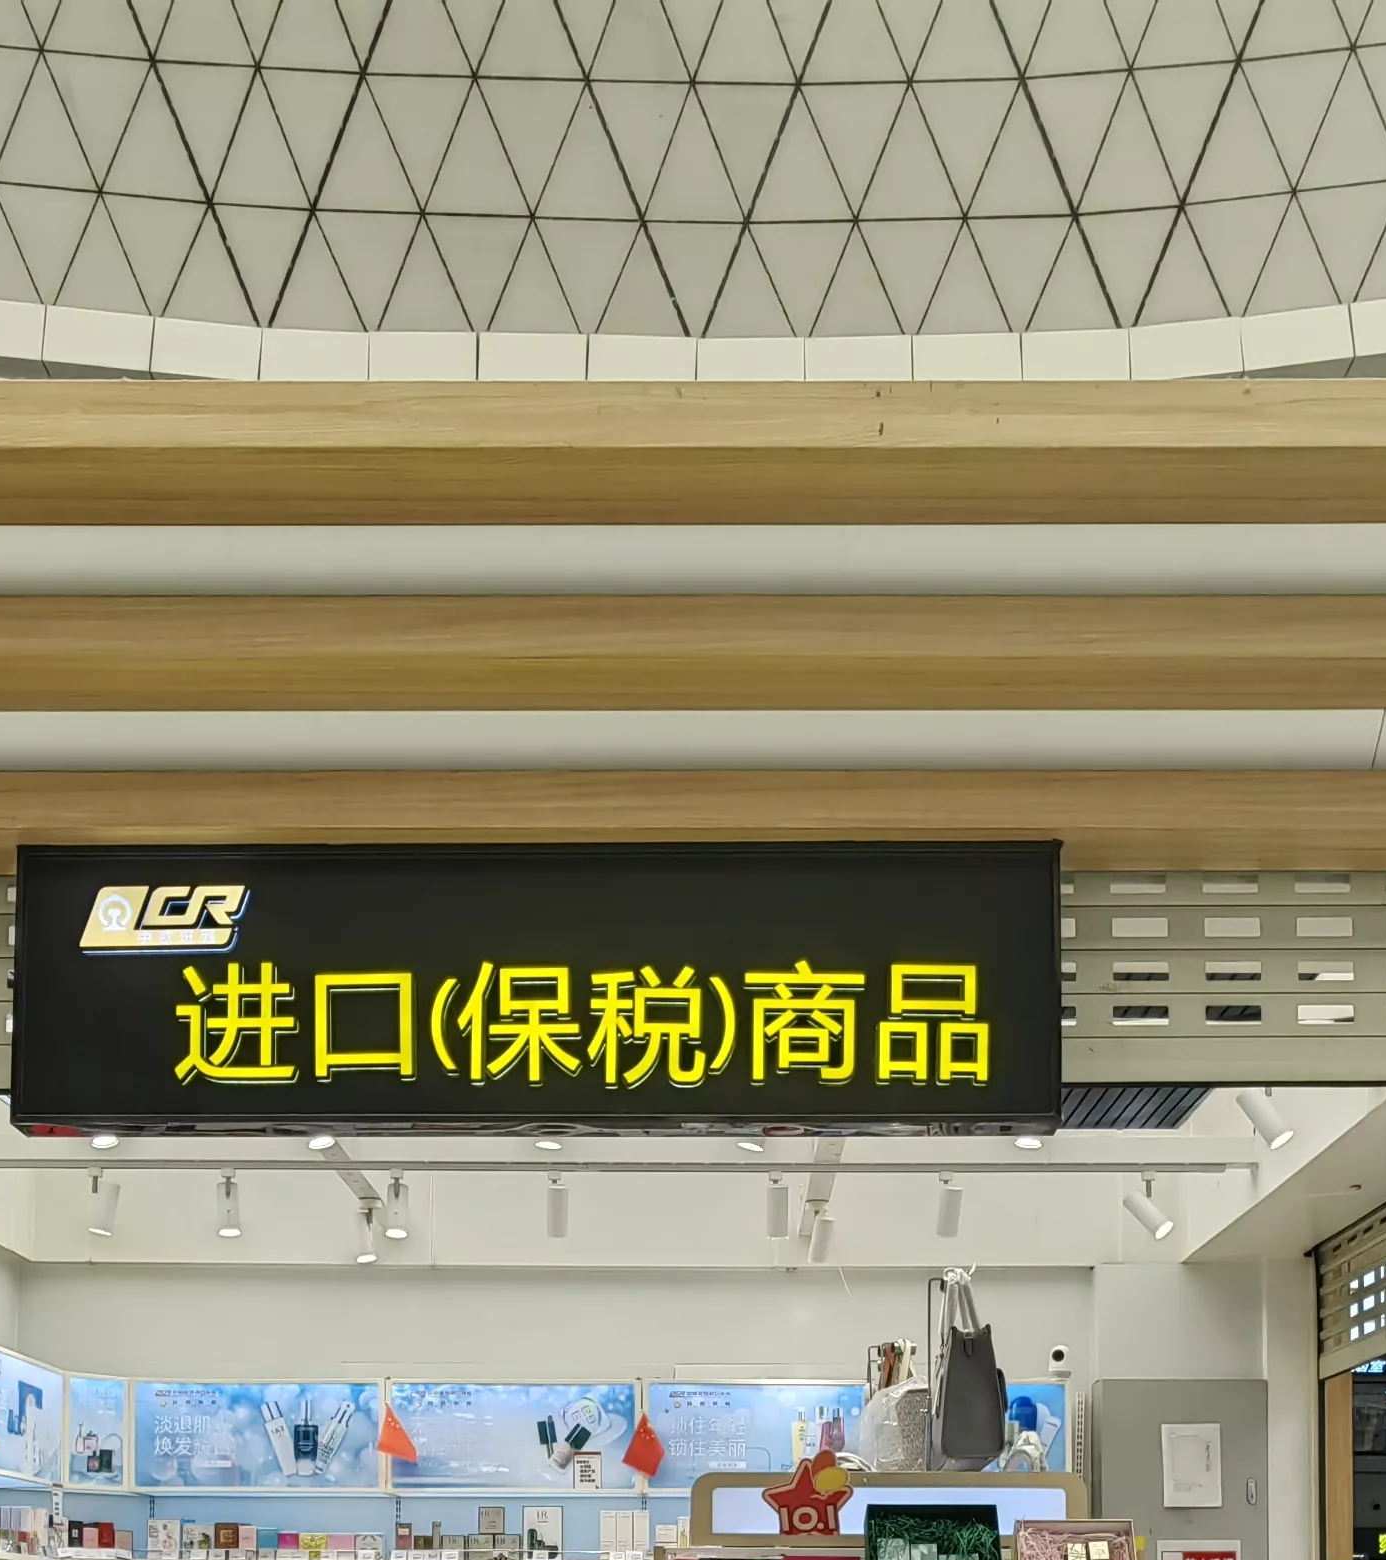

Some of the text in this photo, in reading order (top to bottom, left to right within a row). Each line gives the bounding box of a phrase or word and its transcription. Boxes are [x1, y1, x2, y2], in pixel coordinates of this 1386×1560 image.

[175, 959, 991, 1086] 进口(保税)商品
[779, 1504, 837, 1532] 10.1
